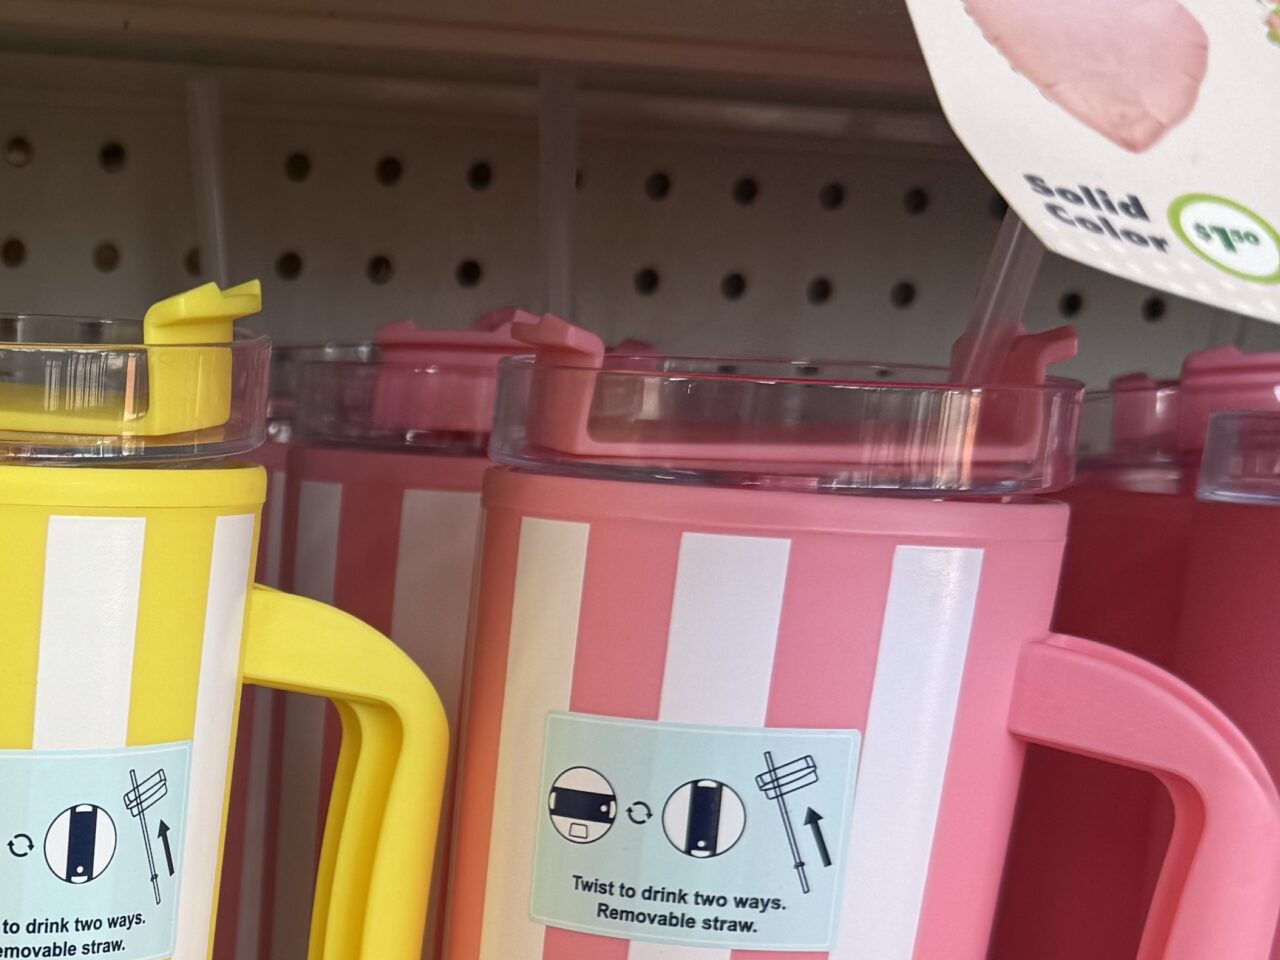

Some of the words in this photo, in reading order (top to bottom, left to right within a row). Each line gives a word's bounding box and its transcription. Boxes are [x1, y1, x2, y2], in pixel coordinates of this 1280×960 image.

[1023, 173, 1151, 223] Solid
[1044, 202, 1170, 254] Color
[572, 875, 615, 896] Twist
[619, 886, 636, 899] to
[641, 886, 688, 905] drink
[693, 890, 728, 908] two
[733, 895, 787, 913] ways.
[2, 917, 21, 934] to
[25, 916, 70, 934] drink
[73, 917, 103, 932] two
[107, 912, 146, 931] ways.
[596, 903, 697, 928] Removable
[701, 917, 758, 934] straw.
[81, 938, 126, 955] straw.
